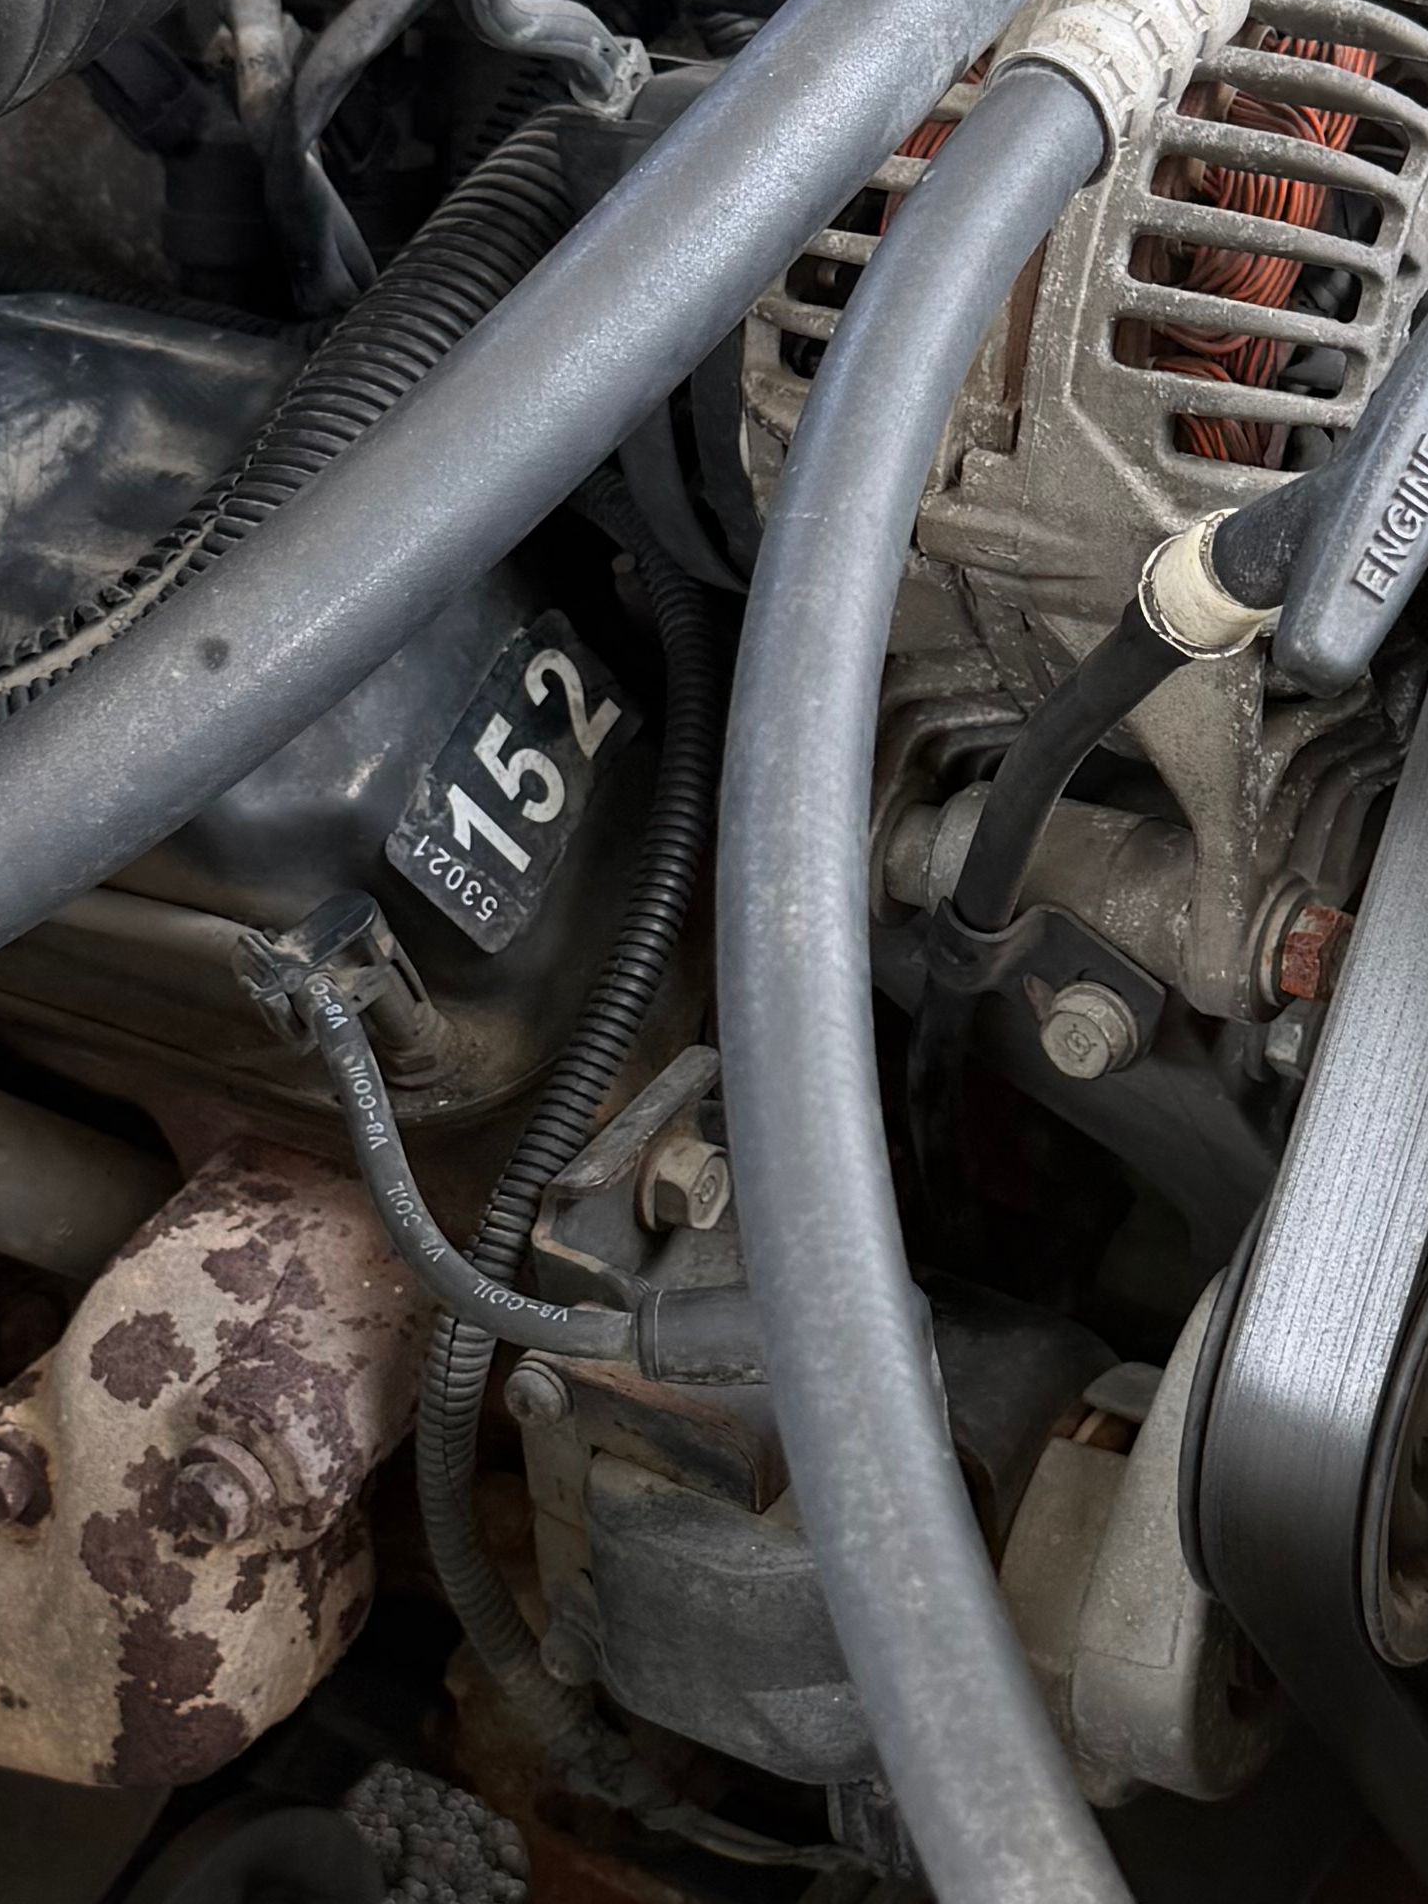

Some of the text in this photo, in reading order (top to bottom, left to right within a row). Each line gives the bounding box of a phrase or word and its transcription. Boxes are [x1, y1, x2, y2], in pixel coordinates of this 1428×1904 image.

[445, 647, 623, 874] 152
[413, 834, 503, 924] 53021
[344, 1057, 390, 1151] V8-COIL
[471, 1277, 571, 1323] V8-COIL
